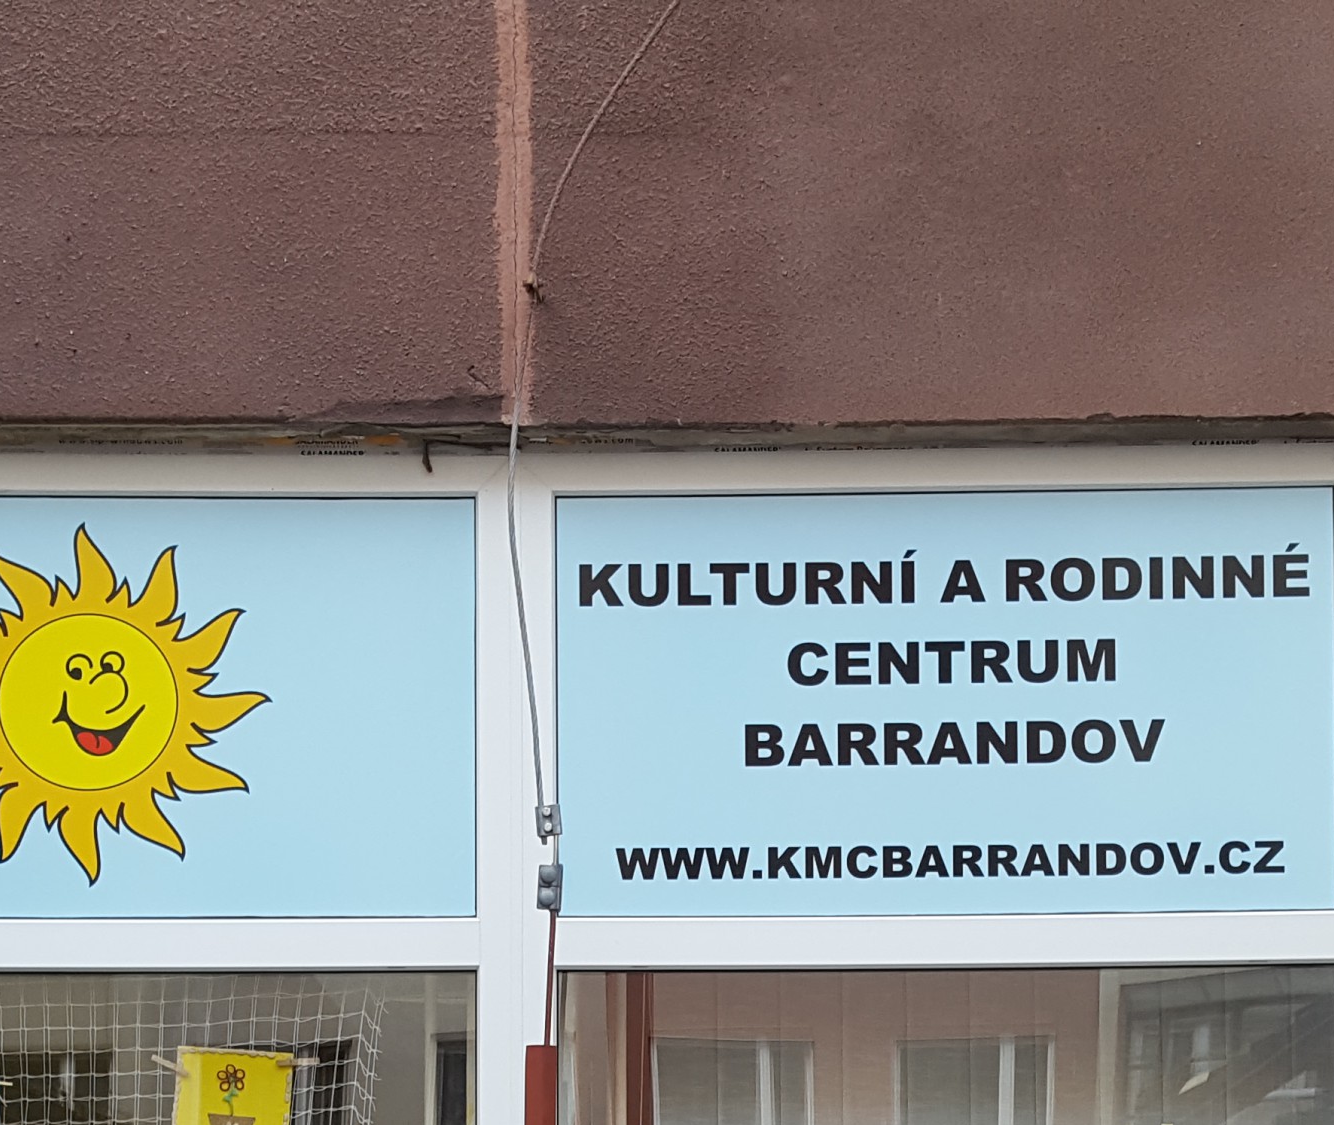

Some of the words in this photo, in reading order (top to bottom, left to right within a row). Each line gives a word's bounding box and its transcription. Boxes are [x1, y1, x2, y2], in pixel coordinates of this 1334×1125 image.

[579, 550, 916, 606] KULTURNÍ
[941, 560, 985, 602] A
[1006, 543, 1309, 601] RODINNÉ
[788, 639, 1115, 686] CENTRUM
[745, 719, 1165, 766] BARRANDOV
[616, 841, 1284, 879] WWW.KMCBARRANDOV.CZ
